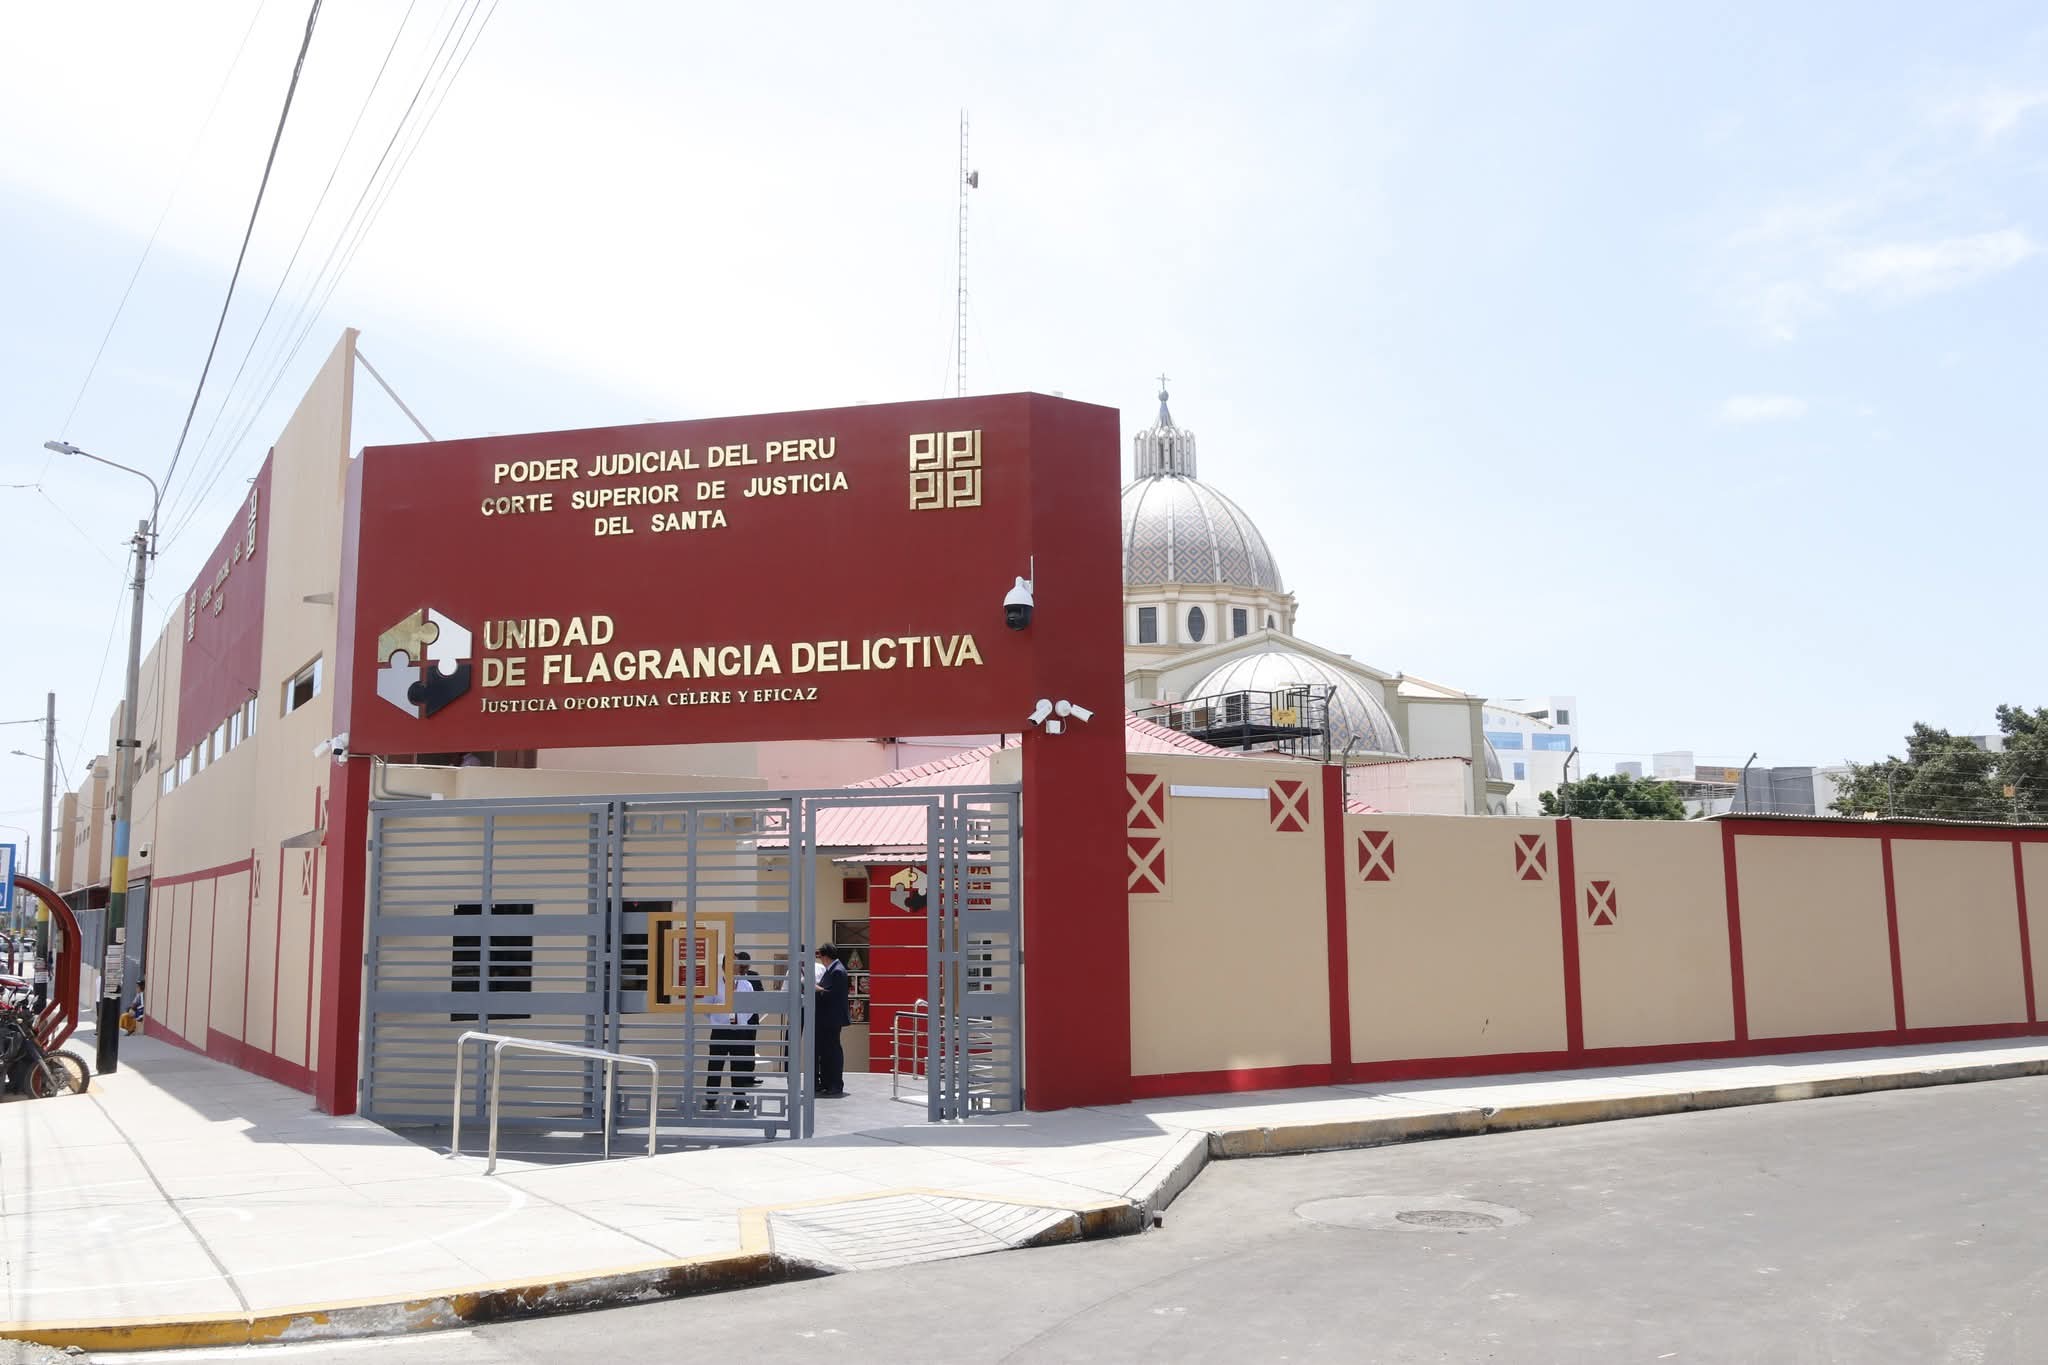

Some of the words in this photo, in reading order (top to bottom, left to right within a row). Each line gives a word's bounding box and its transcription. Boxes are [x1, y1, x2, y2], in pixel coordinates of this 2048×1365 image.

[494, 458, 579, 485] PODER
[587, 448, 700, 478] JUDICIAL
[708, 443, 758, 468] DEL
[766, 436, 836, 463] PERU
[481, 493, 553, 516] CORTE
[571, 484, 680, 510] SUPERIOR
[696, 480, 726, 500] DE
[743, 471, 849, 498] JUSTICIA
[594, 516, 634, 536] DEL
[651, 509, 728, 533] SANTA
[483, 615, 614, 650] UNIDAD
[481, 656, 527, 687] DE
[542, 643, 782, 685] FLAGRANCIA
[791, 633, 984, 674] DELICTIVA
[481, 697, 558, 713] JUSTICIA
[563, 694, 660, 710] OPORTUNA
[737, 690, 749, 703] Y
[753, 687, 818, 703] EFICAZ
